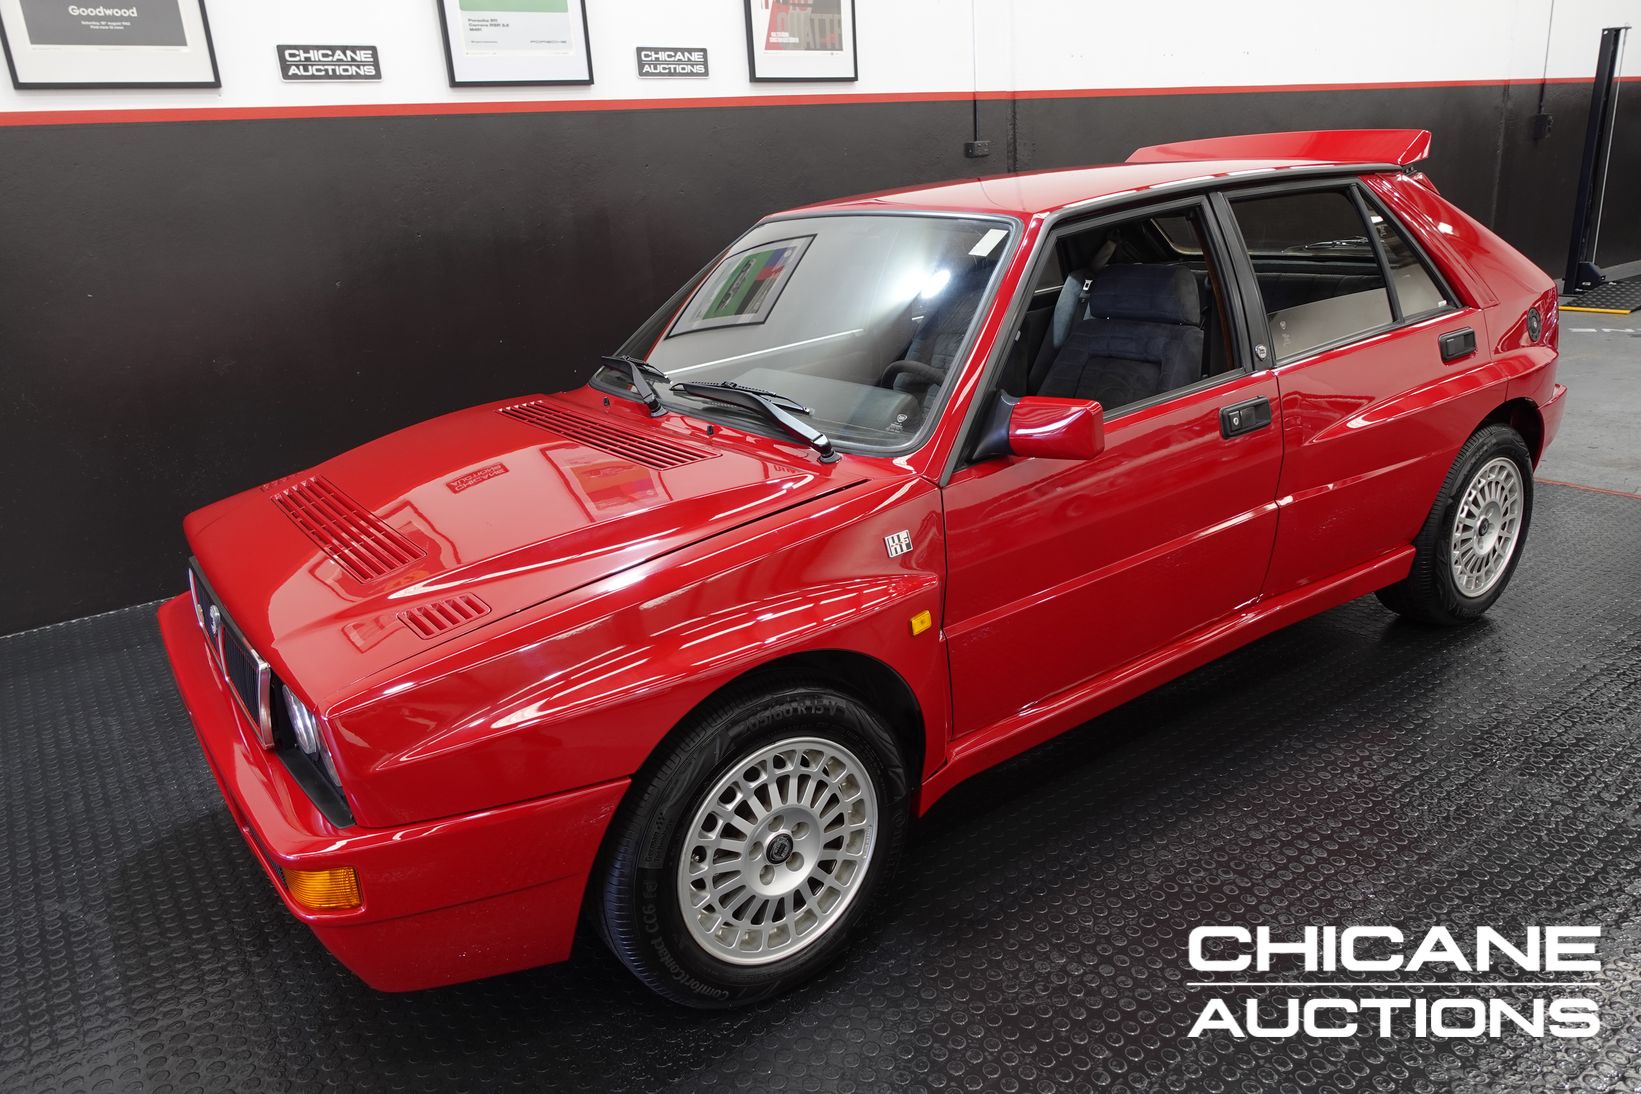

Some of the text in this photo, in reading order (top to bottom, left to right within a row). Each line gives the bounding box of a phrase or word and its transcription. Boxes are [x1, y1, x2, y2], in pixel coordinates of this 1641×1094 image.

[68, 5, 138, 17] Goodwood
[284, 49, 374, 61] CHICANE
[640, 51, 704, 62] CHICANE
[288, 65, 376, 76] AUCTIONS
[642, 64, 705, 74] AUCTIONS
